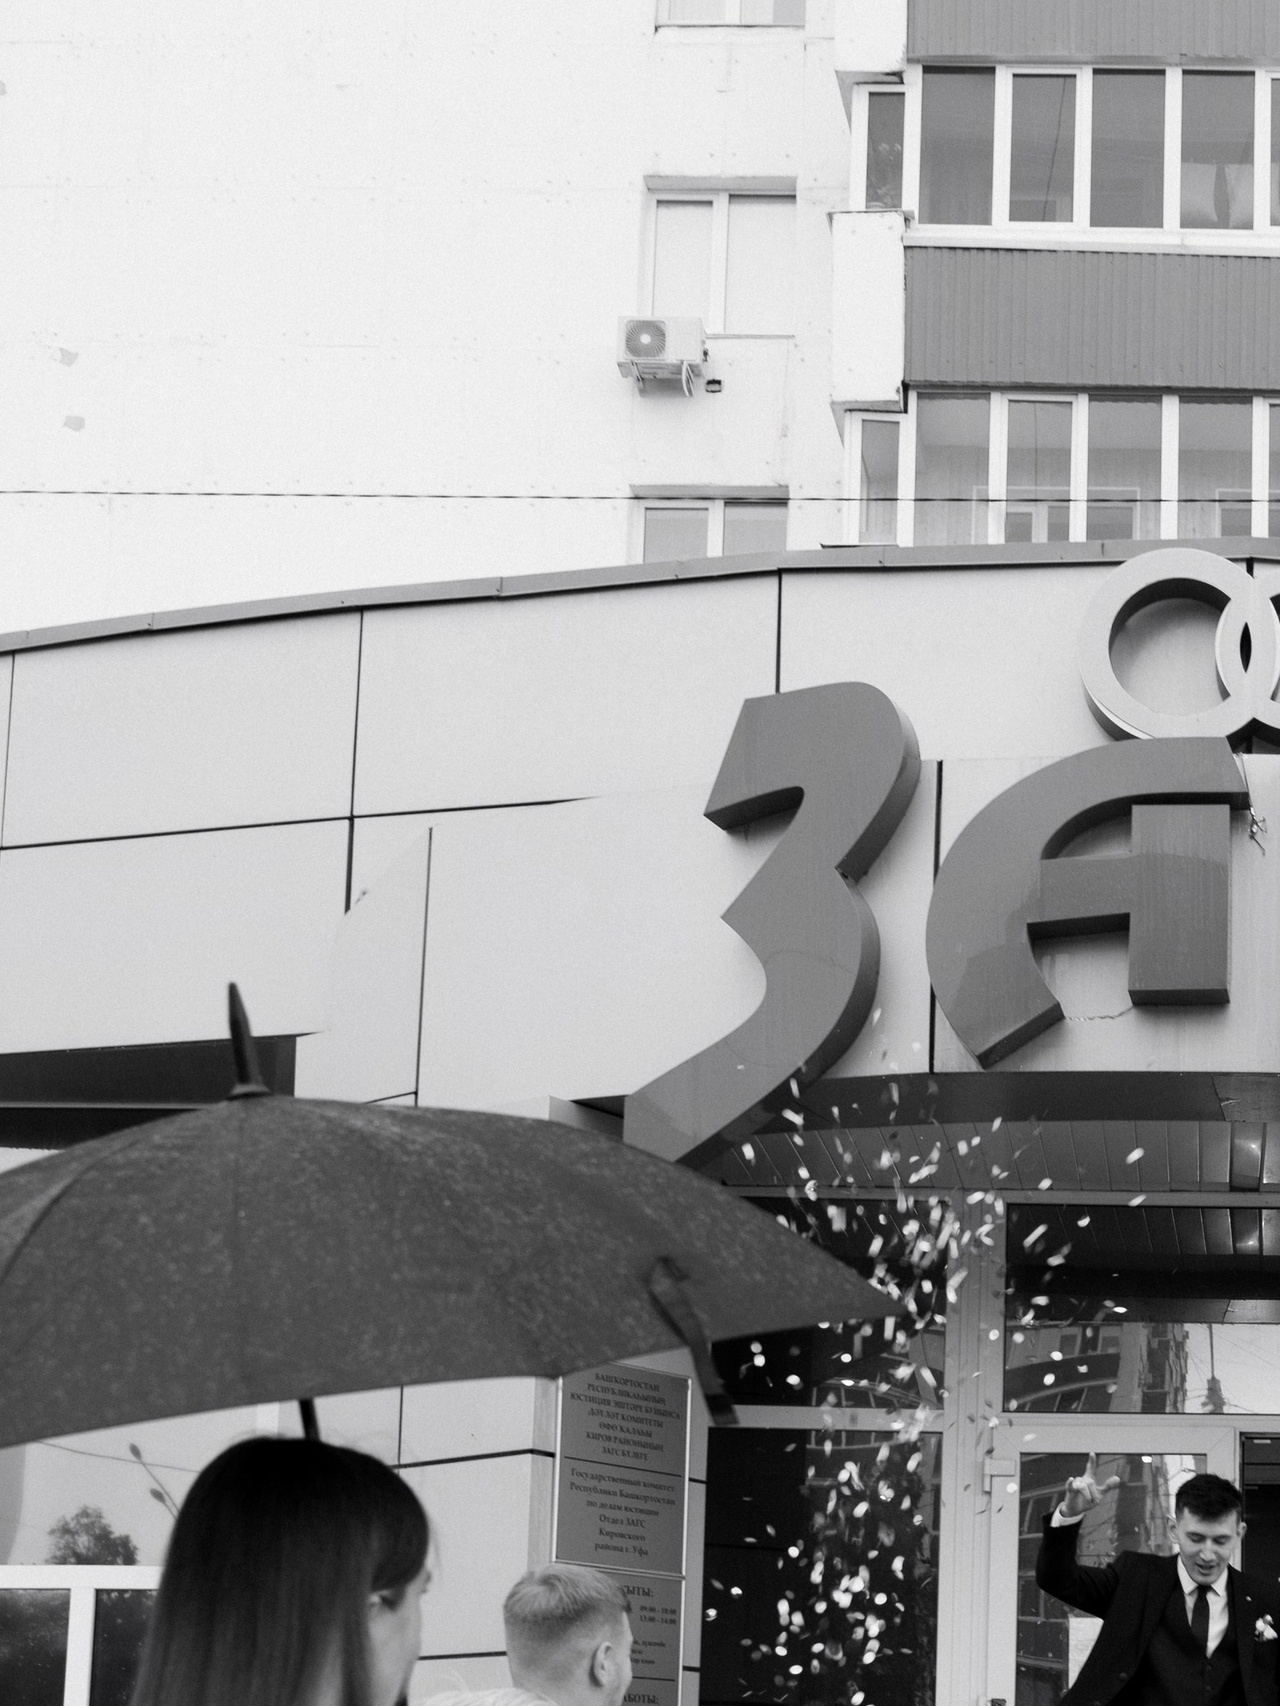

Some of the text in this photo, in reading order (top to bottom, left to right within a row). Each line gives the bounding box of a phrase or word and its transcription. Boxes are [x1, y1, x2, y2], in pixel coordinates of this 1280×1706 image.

[602, 1446, 620, 1457] ЗАГС
[571, 1467, 641, 1487] Государственный
[570, 1481, 675, 1506] Республики Башкортостан
[599, 1514, 646, 1529] Отдел ЗАГС
[599, 1527, 645, 1542] Кировского
